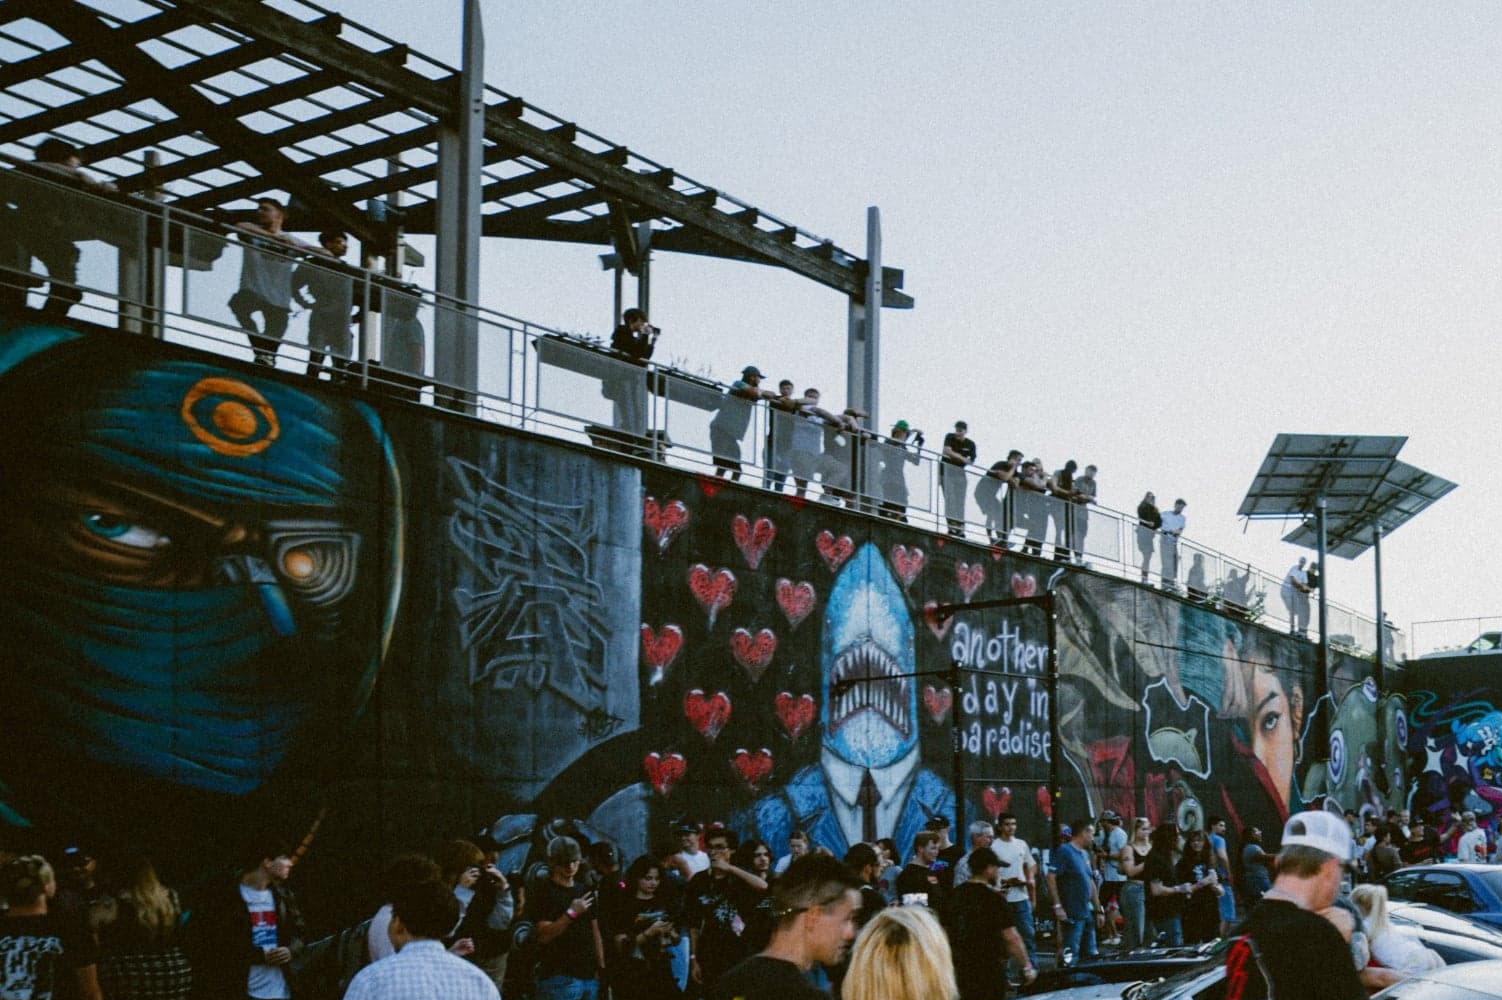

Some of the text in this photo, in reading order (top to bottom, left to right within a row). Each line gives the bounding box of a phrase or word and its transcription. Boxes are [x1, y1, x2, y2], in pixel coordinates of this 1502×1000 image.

[952, 620, 1049, 673] another
[963, 674, 1049, 725] day in
